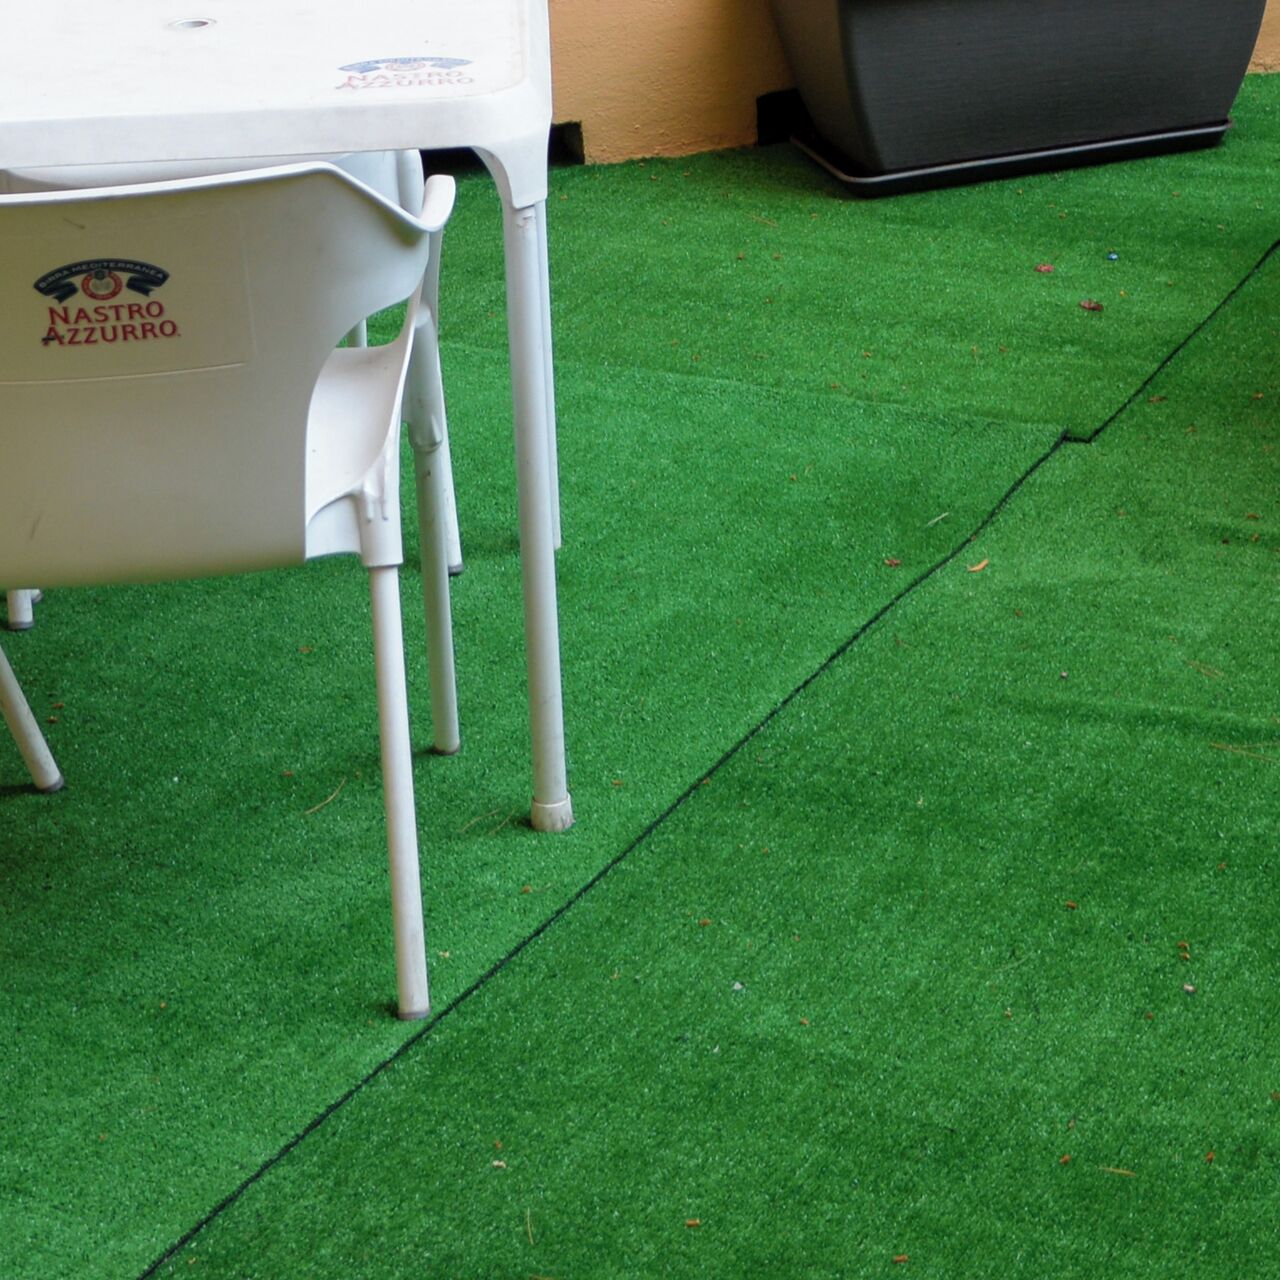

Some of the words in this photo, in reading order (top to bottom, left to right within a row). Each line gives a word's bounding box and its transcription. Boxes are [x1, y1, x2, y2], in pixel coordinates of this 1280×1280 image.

[38, 269, 69, 289] BIRRA
[72, 261, 165, 279] MEDITERRANEA
[48, 301, 165, 326] NASTRO
[41, 320, 177, 347] AZZURRO
